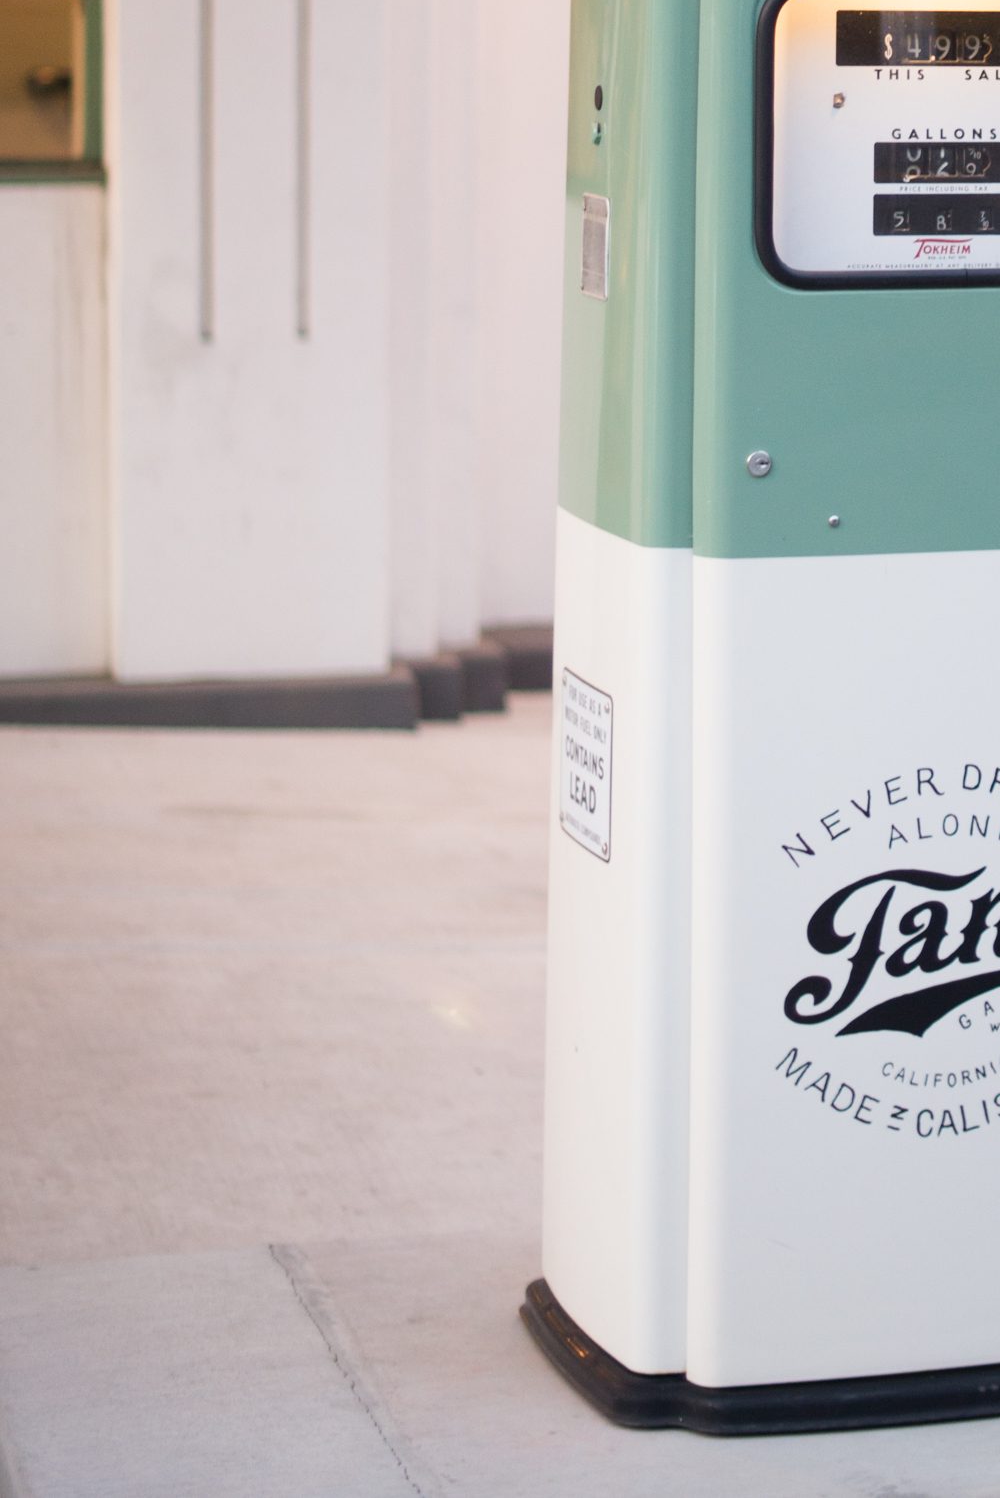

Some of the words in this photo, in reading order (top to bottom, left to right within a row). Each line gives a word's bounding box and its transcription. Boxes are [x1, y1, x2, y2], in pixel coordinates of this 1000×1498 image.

[874, 68, 925, 81] THIS
[891, 128, 997, 140] GALLONS
[566, 734, 604, 780] CONTAINS
[570, 771, 597, 814] LEAD
[782, 767, 945, 868] NEVER
[775, 1047, 880, 1124] MADE
